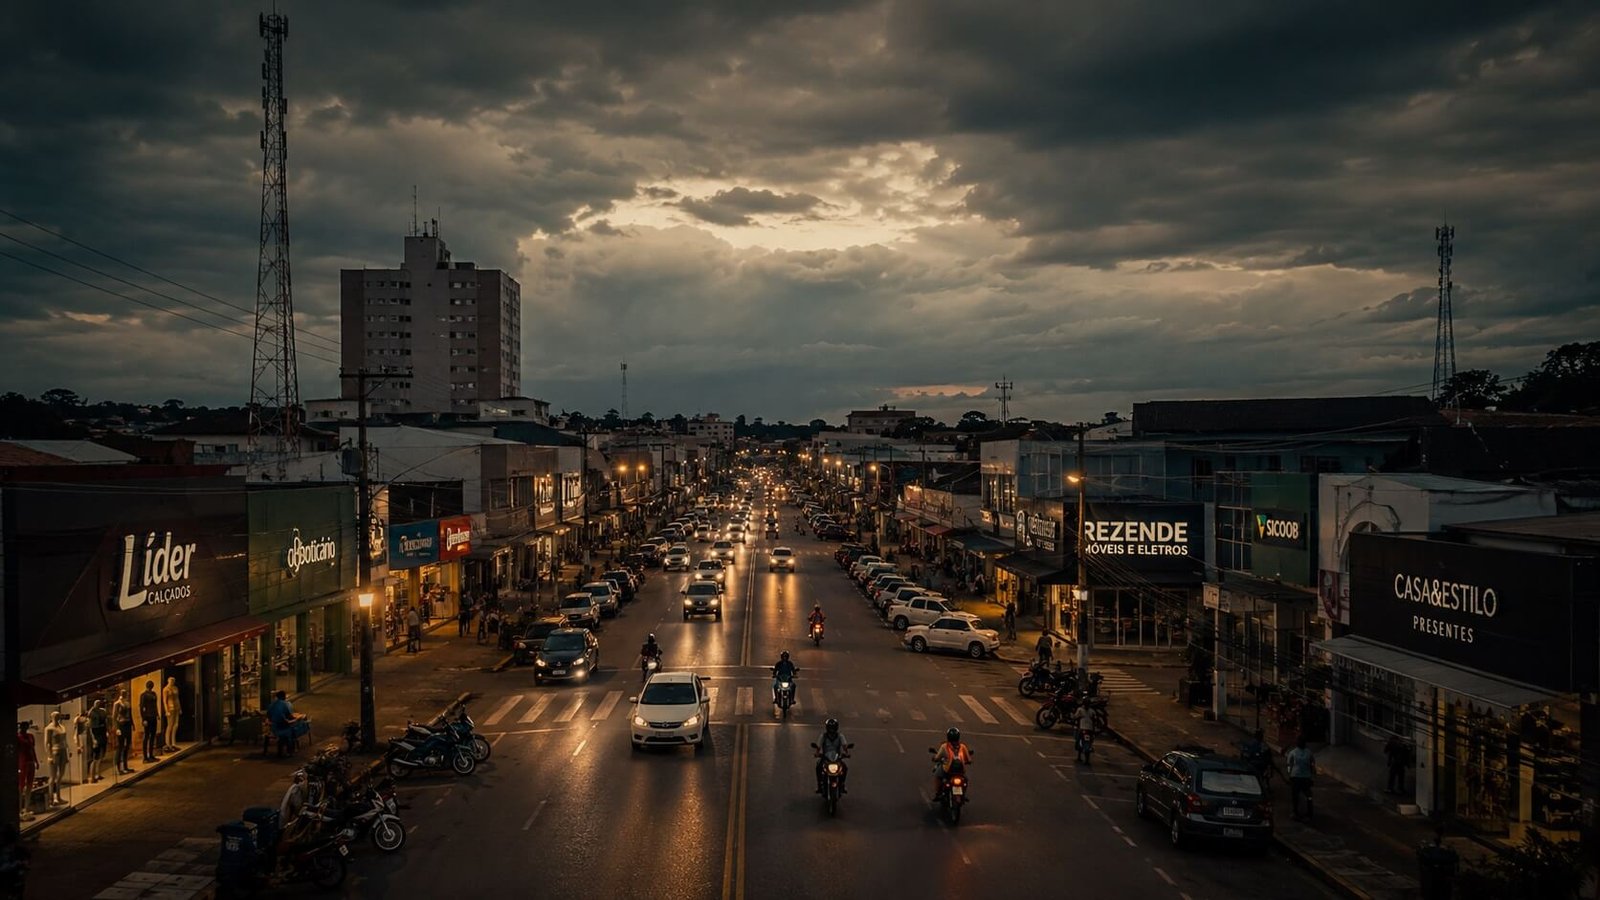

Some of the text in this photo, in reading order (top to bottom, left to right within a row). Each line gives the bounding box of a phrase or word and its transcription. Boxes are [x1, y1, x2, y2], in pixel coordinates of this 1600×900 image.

[1084, 521, 1188, 543] REZENDE
[1266, 519, 1299, 540] SICOOB
[1128, 544, 1135, 555] E
[1137, 544, 1188, 556] ELETROS
[119, 531, 196, 611] Líder
[147, 585, 191, 605] CALÇADOS
[1394, 573, 1497, 618] CASA&ESTILO
[1413, 615, 1474, 644] PRESENTES
